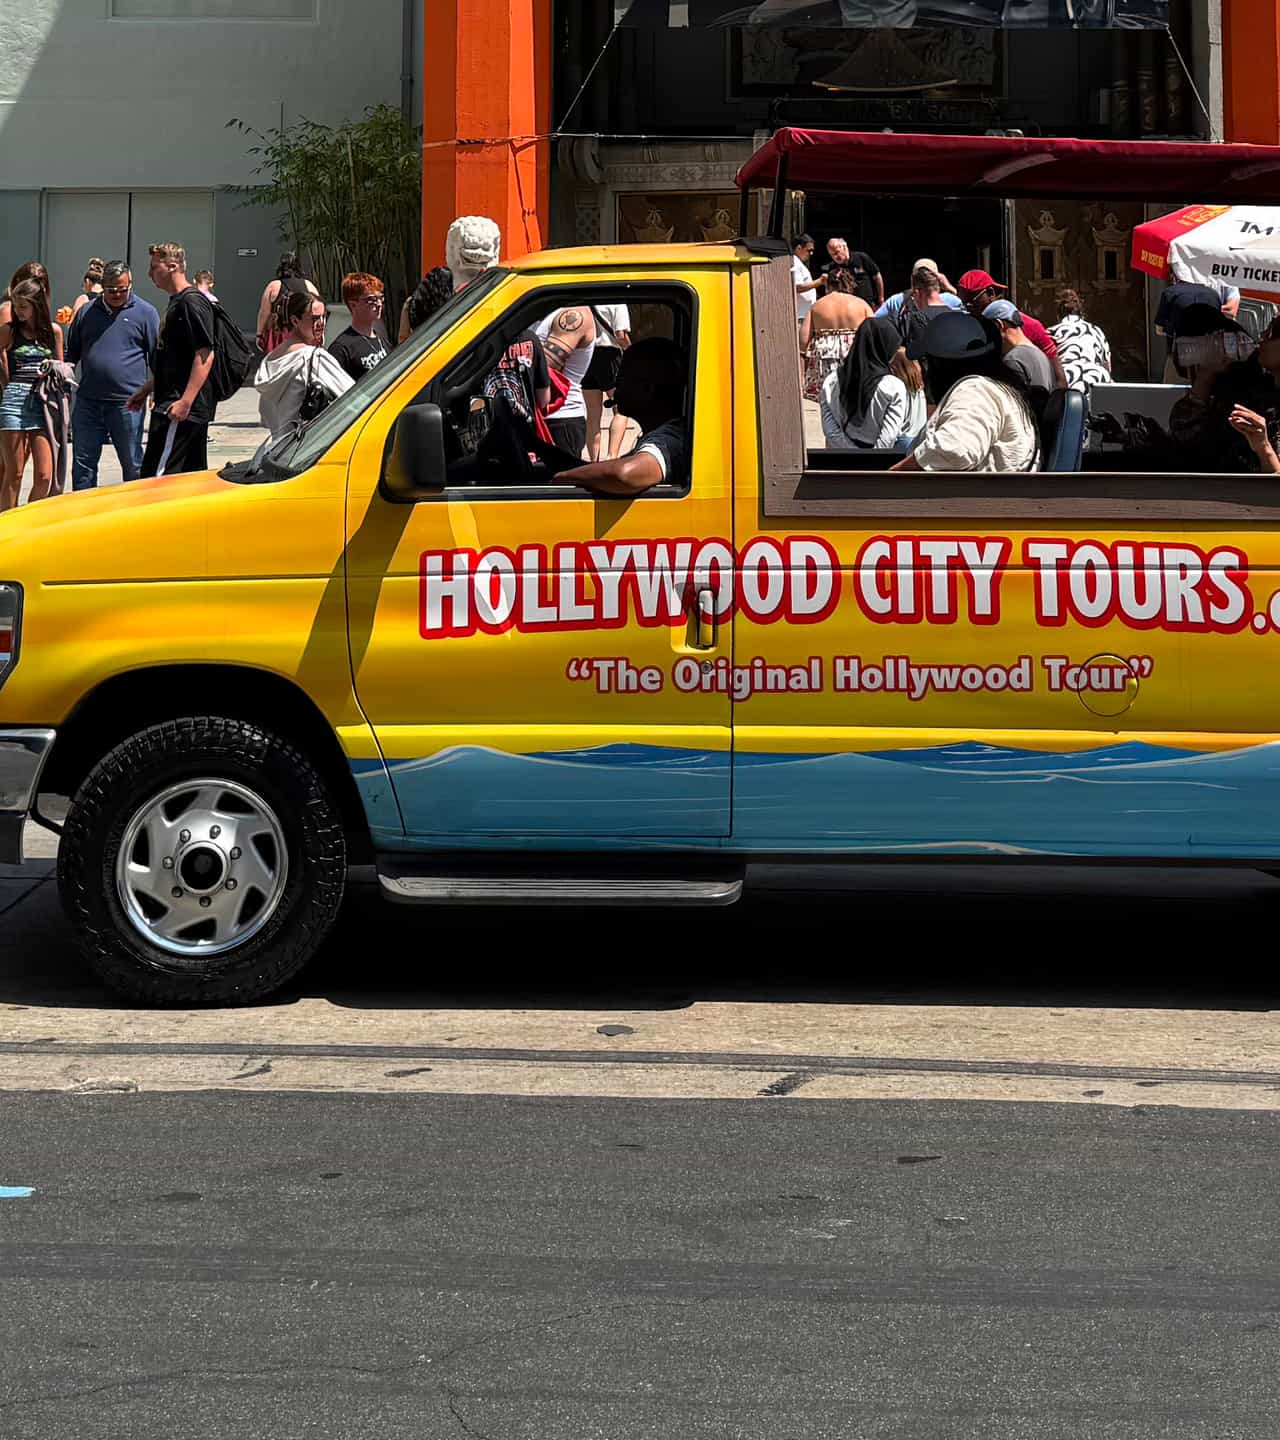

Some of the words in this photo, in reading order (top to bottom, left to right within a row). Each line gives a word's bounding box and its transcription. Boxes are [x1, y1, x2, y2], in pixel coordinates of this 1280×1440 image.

[1211, 263, 1239, 278] BUY
[423, 539, 835, 633] HOLLYWOOD
[860, 539, 1007, 623] CITY
[673, 657, 823, 699] Original
[834, 657, 1032, 700] Hollywood
